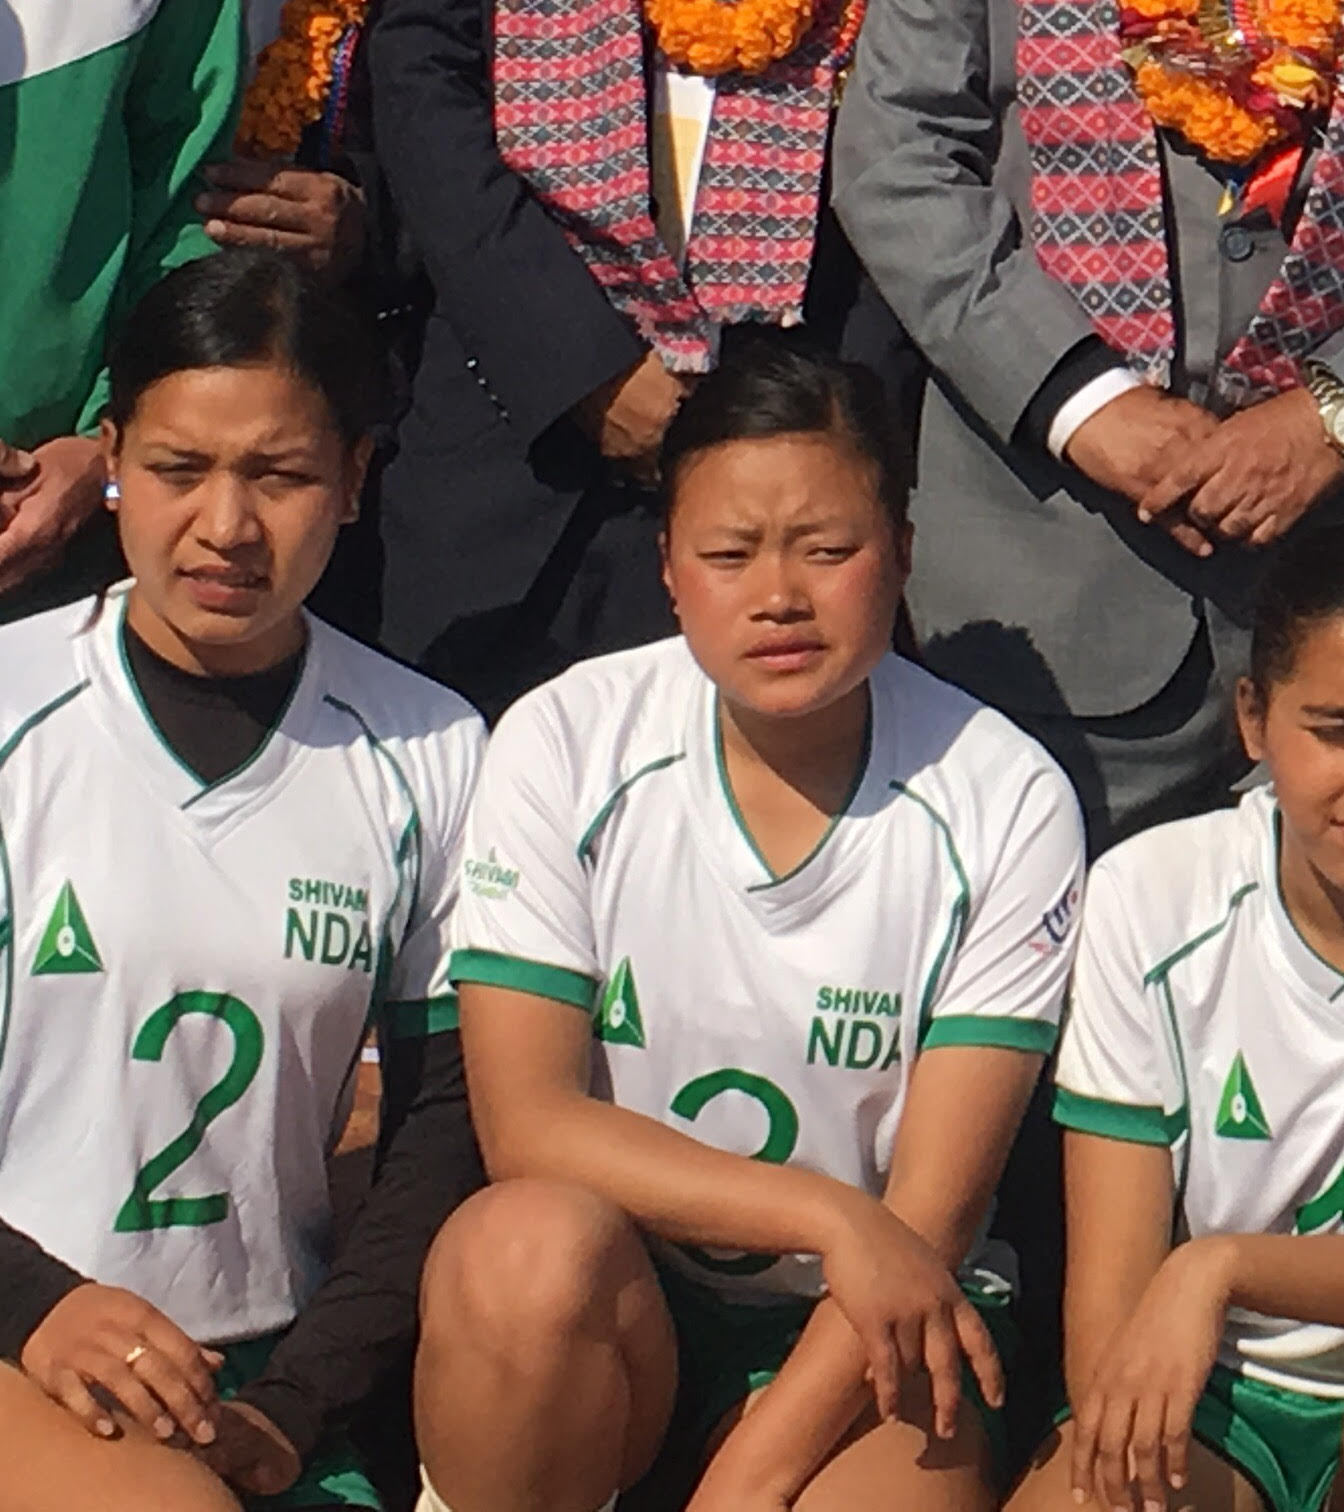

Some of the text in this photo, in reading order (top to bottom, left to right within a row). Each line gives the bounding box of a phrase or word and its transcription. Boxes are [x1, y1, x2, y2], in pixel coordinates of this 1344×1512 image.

[288, 878, 369, 911] SHIVAM
[283, 907, 373, 973] NDA
[112, 989, 265, 1234] 2
